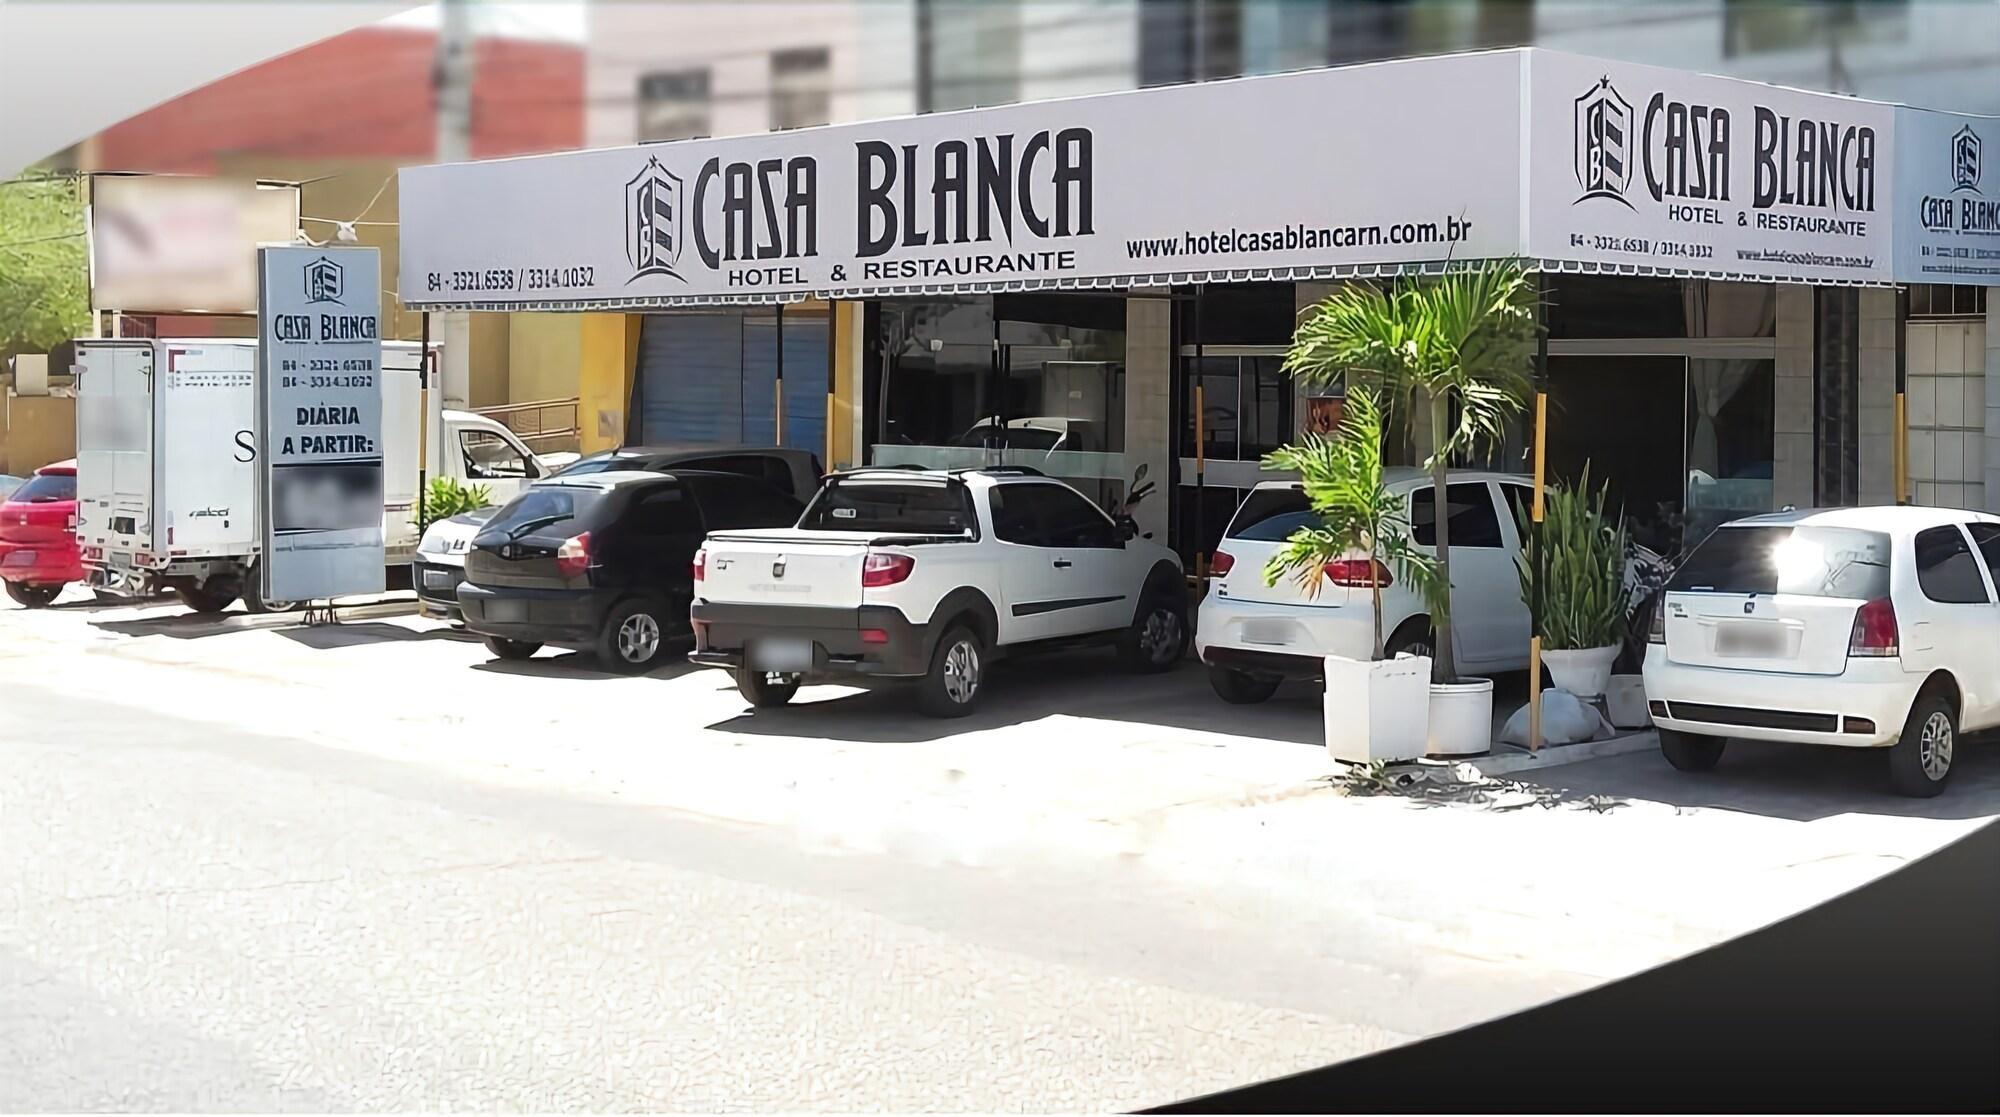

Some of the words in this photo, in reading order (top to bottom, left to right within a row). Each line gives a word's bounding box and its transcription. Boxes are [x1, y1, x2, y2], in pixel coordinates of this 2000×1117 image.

[1642, 92, 1730, 202] CASA
[1752, 105, 1876, 214] BLANCA
[692, 156, 818, 270] CASA
[855, 127, 1096, 259] BLANCA
[1921, 195, 1953, 229] CASA
[1126, 215, 1472, 260] www.hotelcasablancarn.com.br
[1669, 204, 1723, 225] HOTEL
[1737, 211, 1748, 226] &
[1757, 211, 1867, 237] RESTAURANTE
[728, 265, 809, 287] HOTEL
[830, 264, 848, 282] &
[863, 250, 1076, 281] RESTAURANTE
[274, 313, 311, 342] CASA
[320, 313, 377, 341] BLANCA
[296, 401, 360, 426] DIÁRIA
[281, 436, 295, 455] A
[301, 434, 374, 454] PARTIR:
